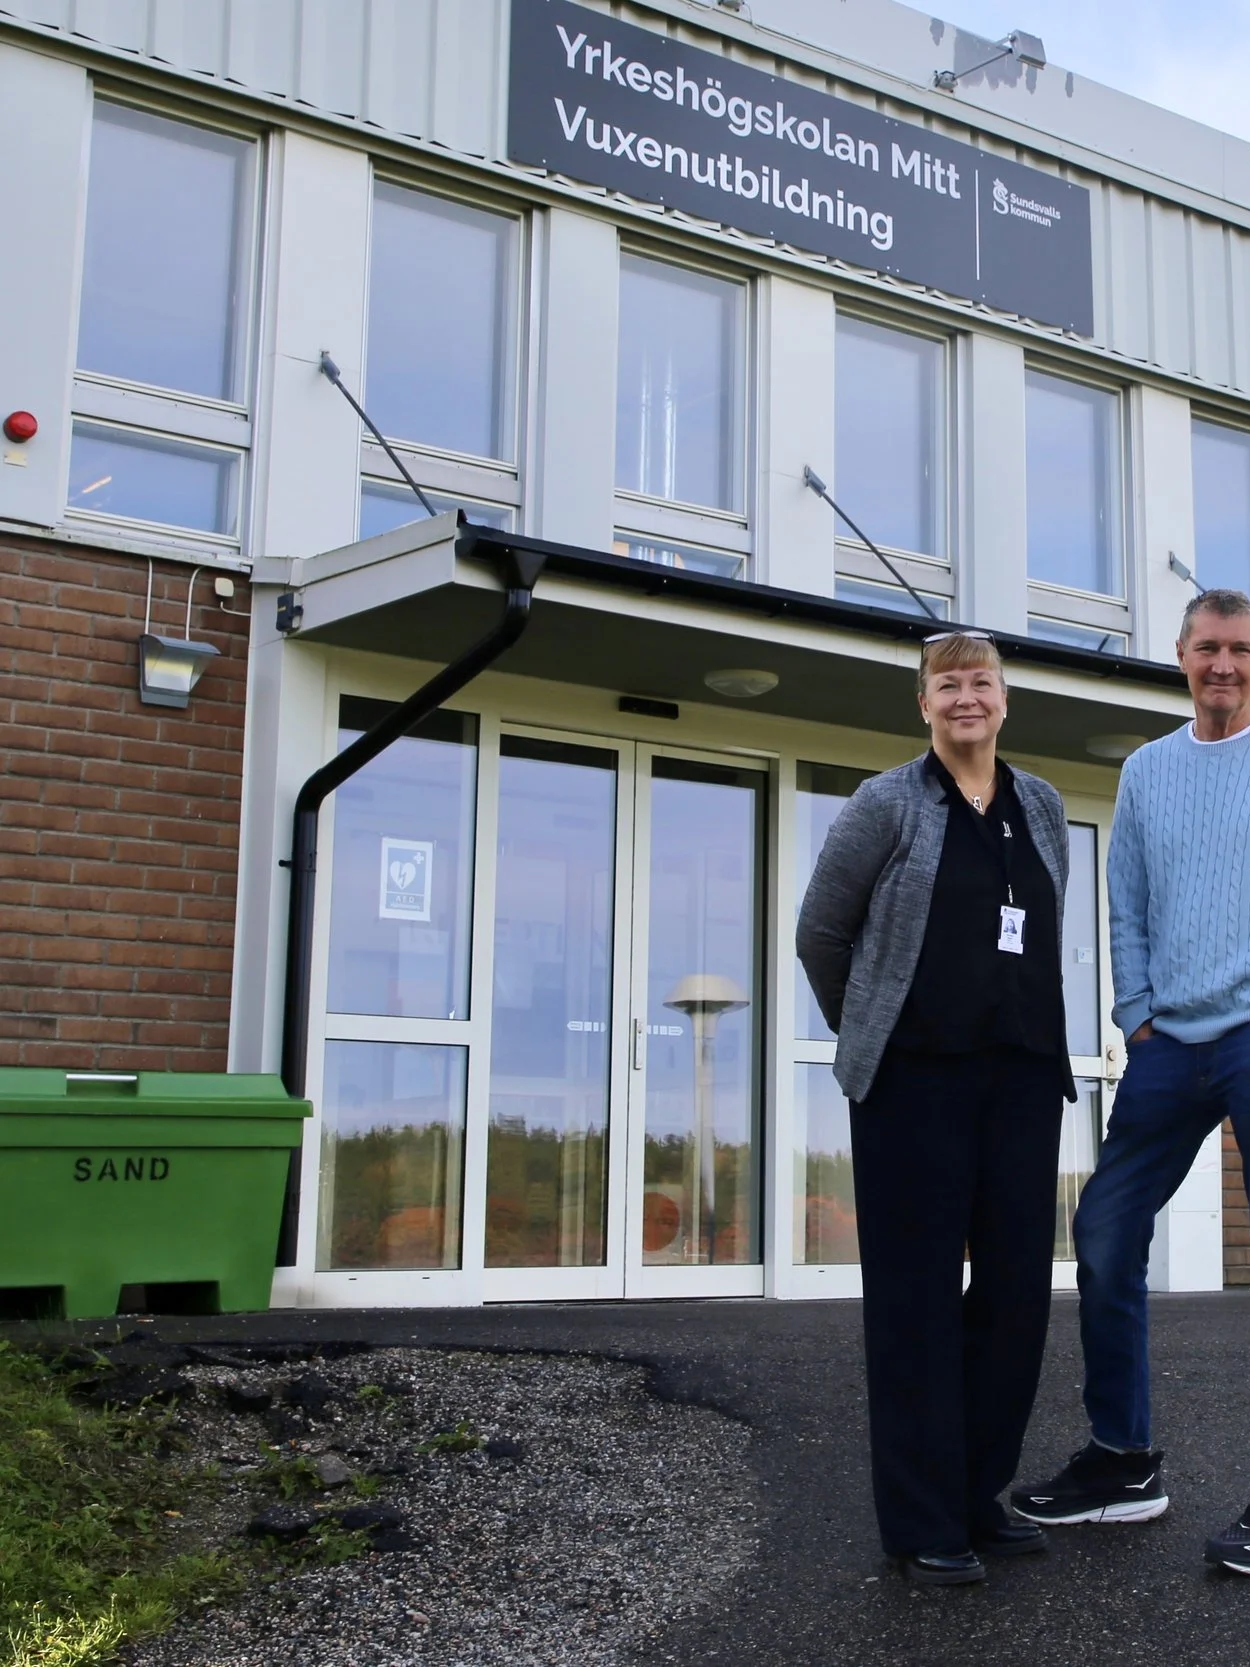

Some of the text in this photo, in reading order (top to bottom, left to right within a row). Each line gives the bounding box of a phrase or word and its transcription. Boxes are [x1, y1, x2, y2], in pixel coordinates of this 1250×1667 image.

[555, 24, 962, 200] Yrkeshögskolan Mitt
[554, 97, 894, 252] Vuxenutbildning
[1010, 192, 1061, 220] Sundsvalls
[1010, 204, 1052, 228] kommun
[73, 1157, 170, 1181] SAND
